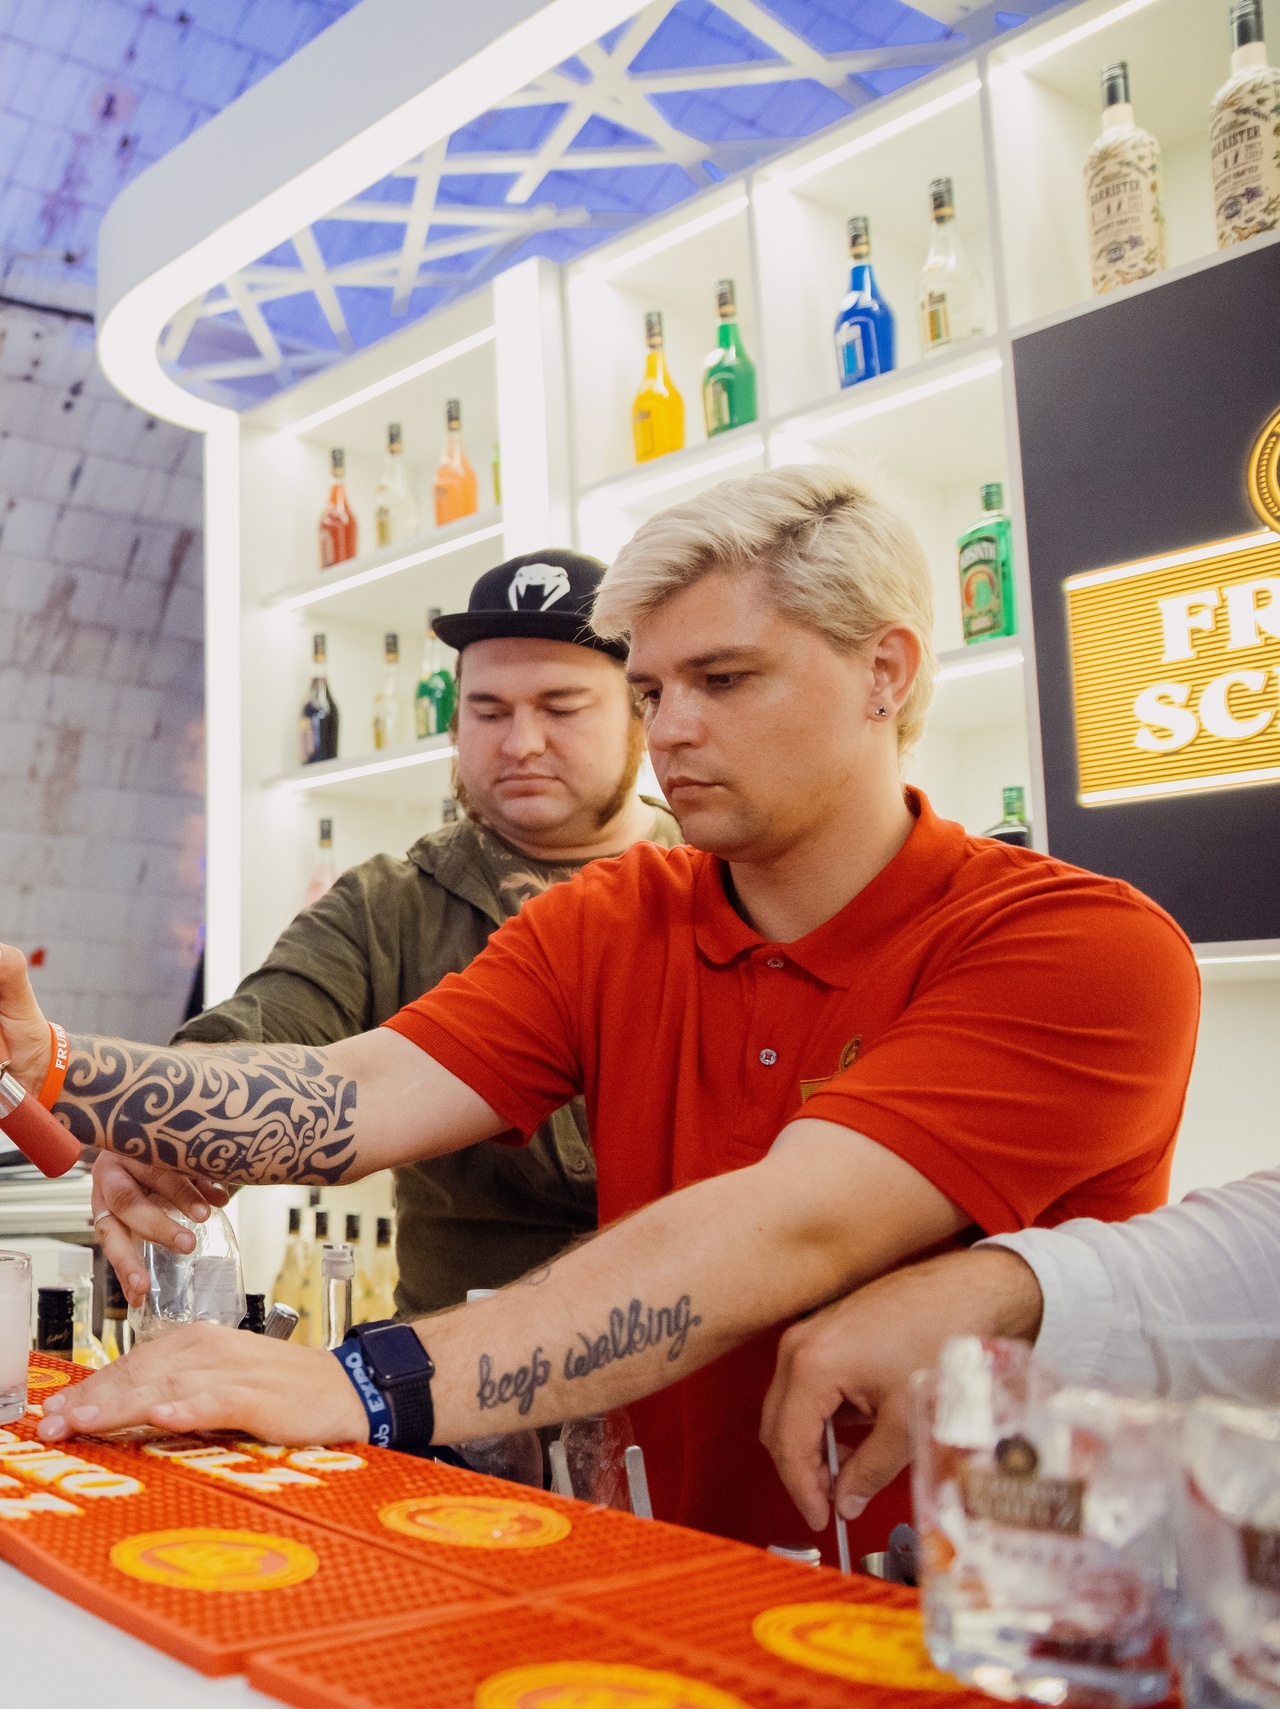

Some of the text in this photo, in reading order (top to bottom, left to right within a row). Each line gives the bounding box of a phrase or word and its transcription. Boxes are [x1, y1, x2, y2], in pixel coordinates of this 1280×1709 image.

[1158, 579, 1280, 663] FR
[1133, 665, 1280, 754] SC
[345, 1352, 385, 1413] EXPO
[477, 1346, 550, 1415] keep
